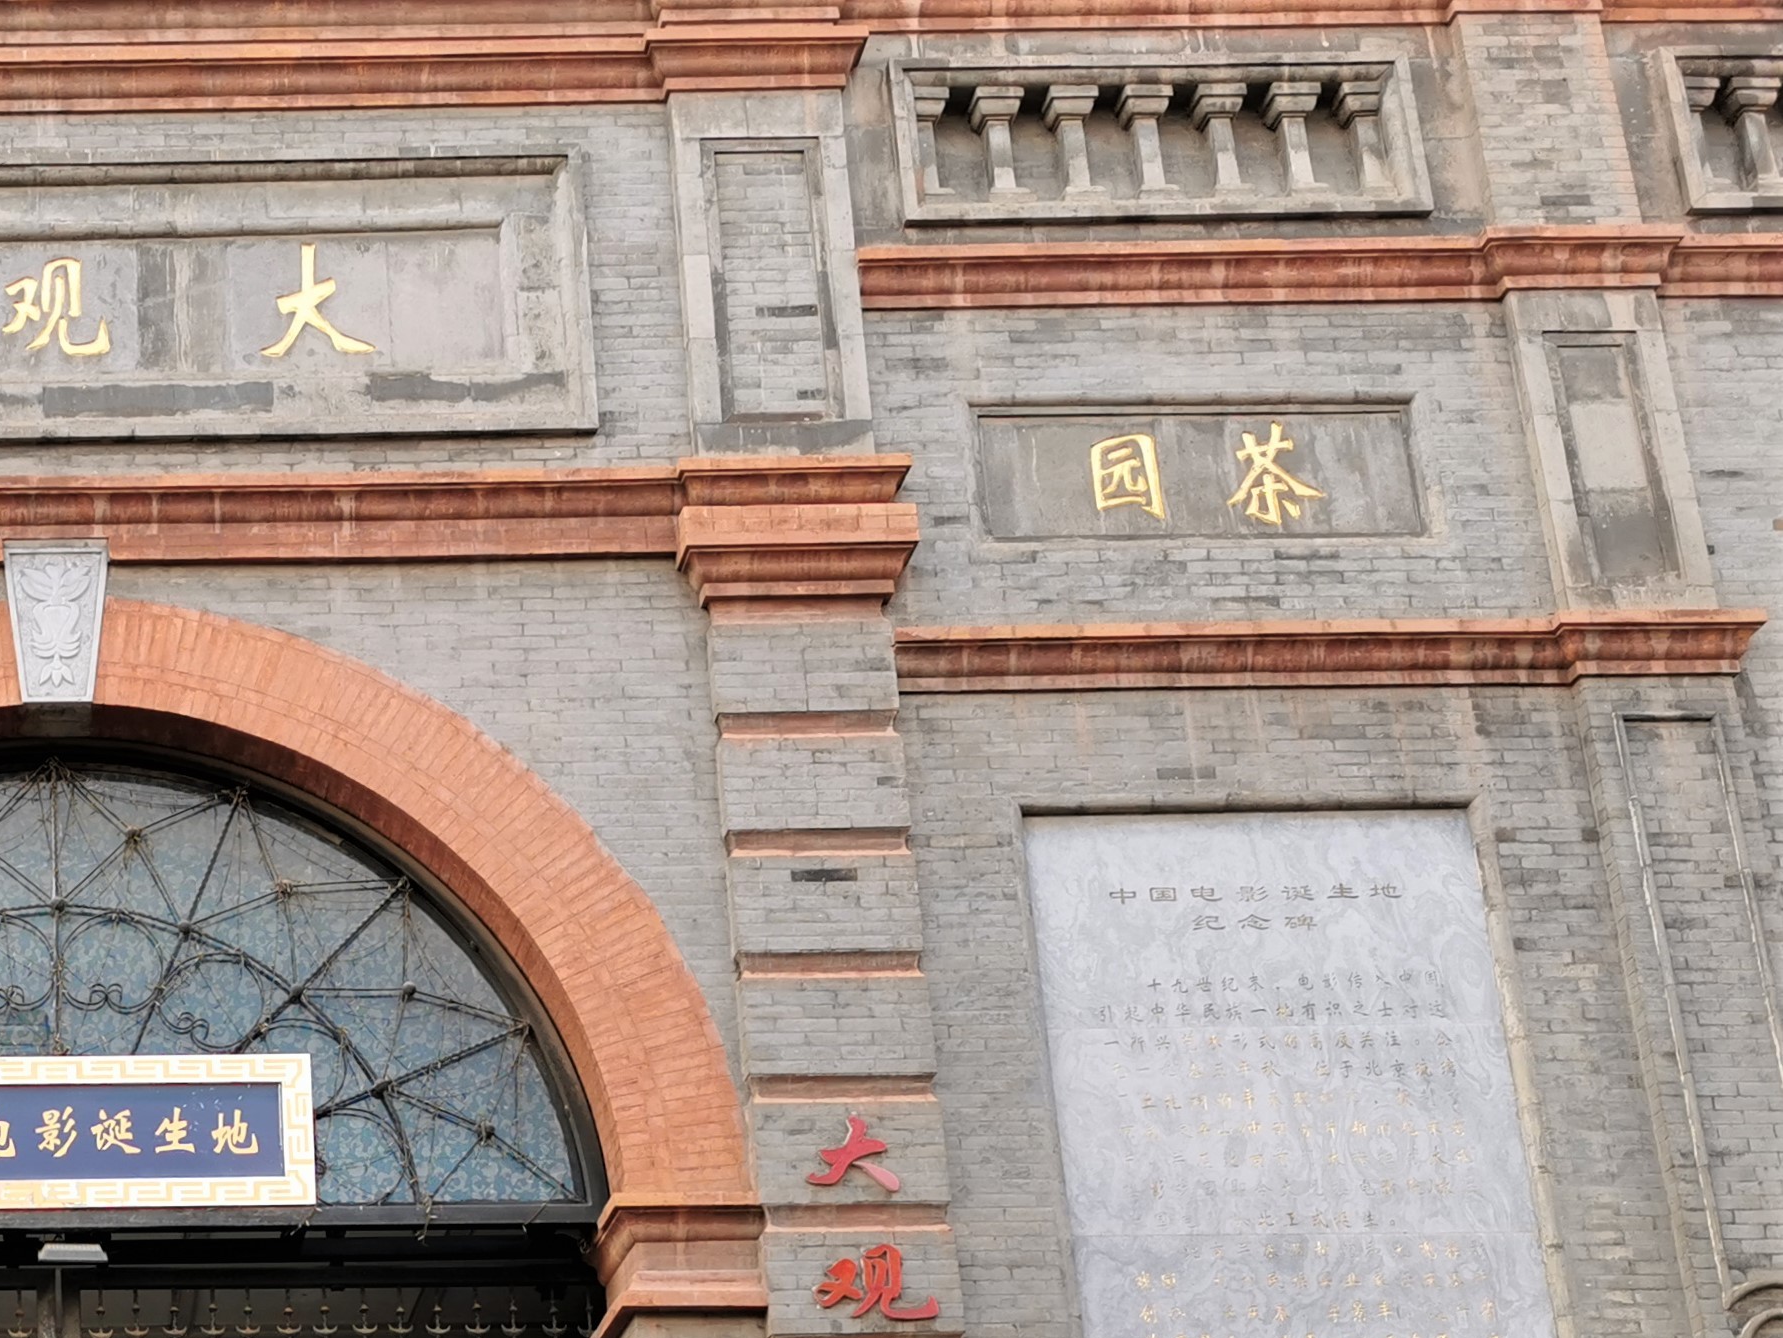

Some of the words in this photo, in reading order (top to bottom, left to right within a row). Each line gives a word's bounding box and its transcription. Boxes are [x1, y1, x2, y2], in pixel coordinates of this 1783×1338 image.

[1109, 882, 1404, 904] 中国电影诞生地
[1192, 913, 1318, 931] 纪念碑
